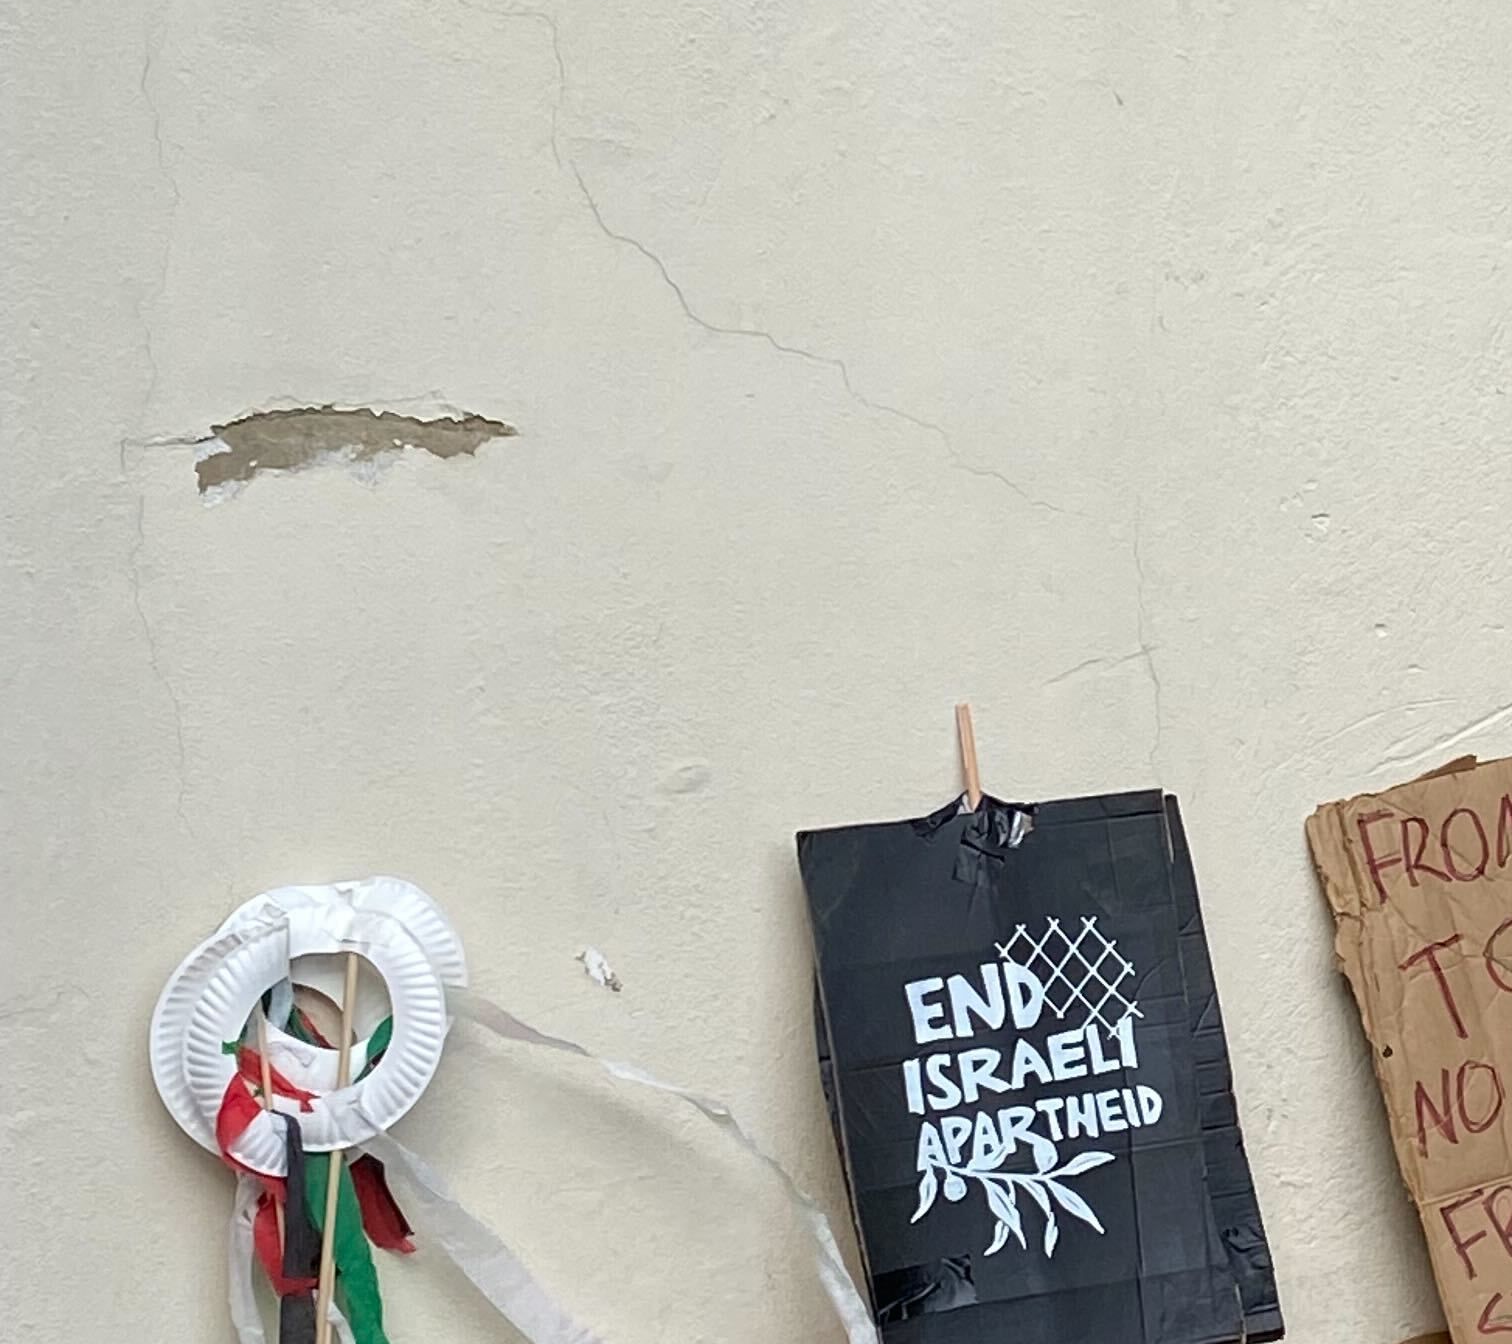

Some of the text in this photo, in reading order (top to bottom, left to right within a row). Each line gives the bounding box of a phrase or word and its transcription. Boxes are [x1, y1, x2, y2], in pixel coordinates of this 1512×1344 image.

[905, 963, 1044, 1043] END
[903, 1018, 1138, 1115] ISRAELI
[1415, 1063, 1503, 1158] NO
[917, 1086, 1162, 1171] APARTHEID
